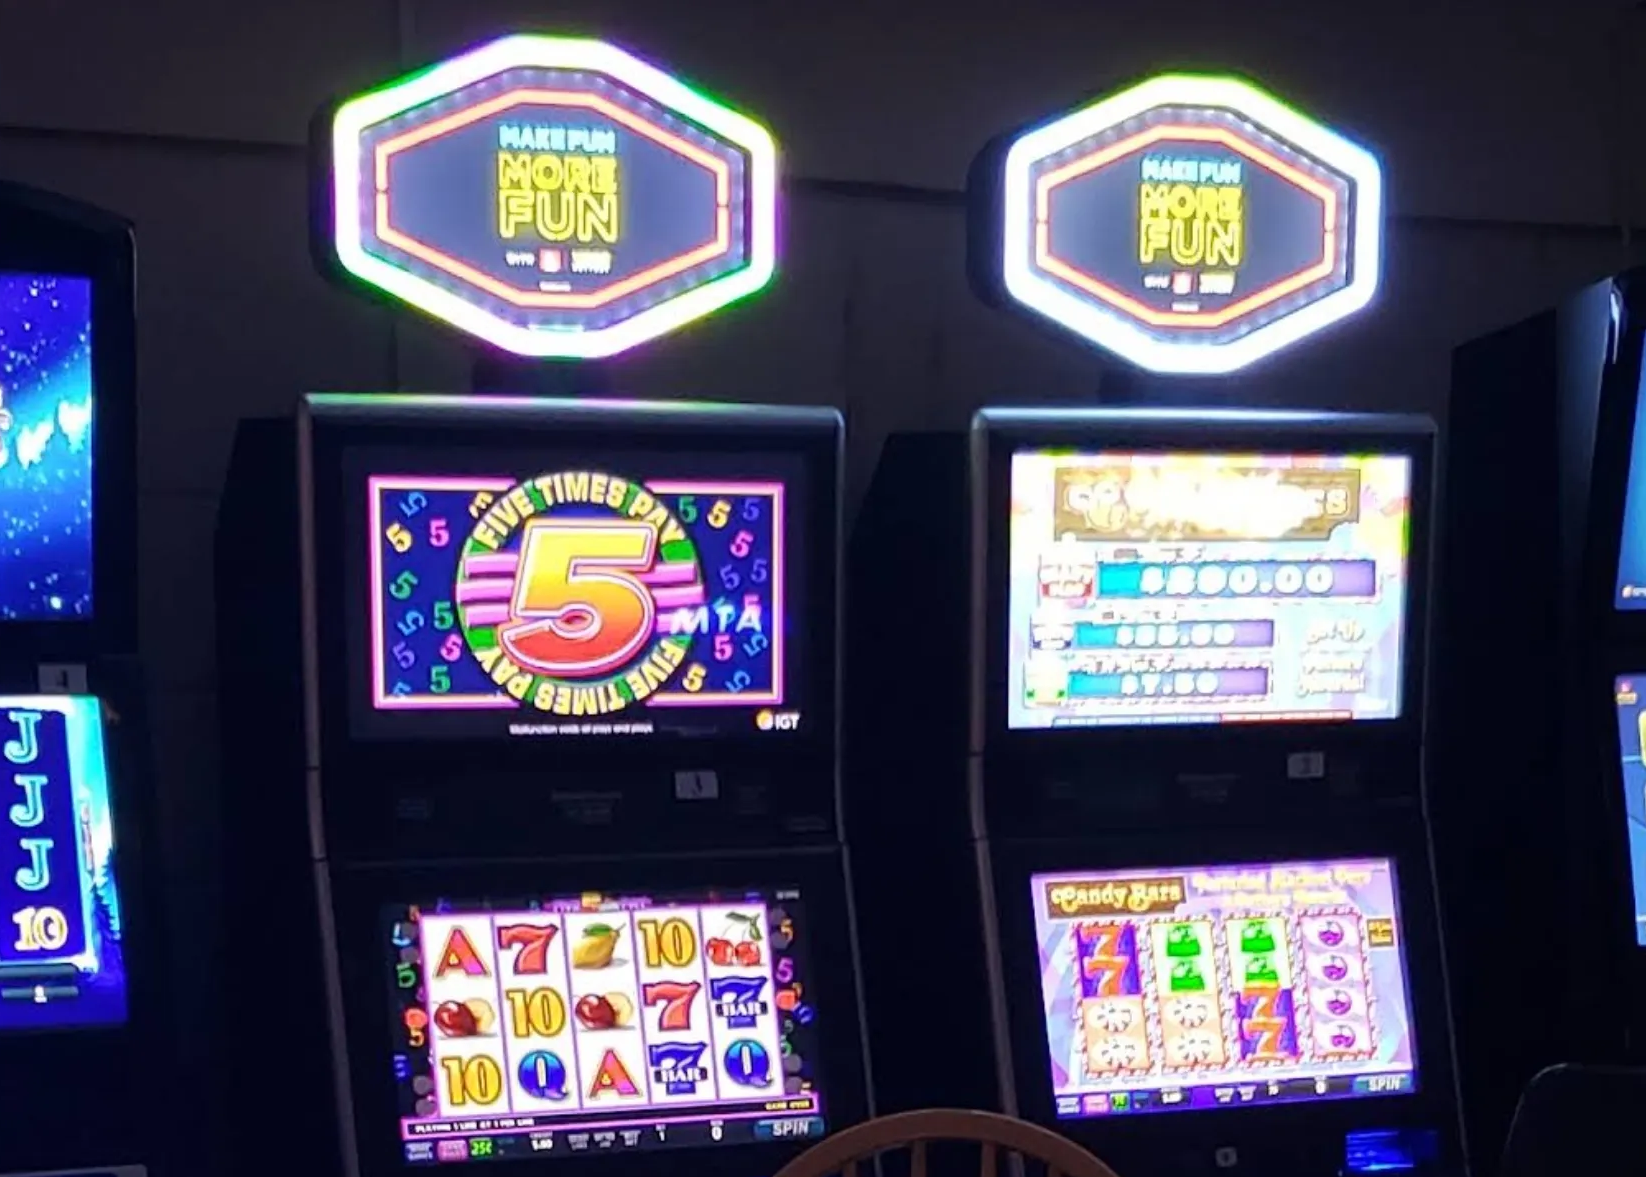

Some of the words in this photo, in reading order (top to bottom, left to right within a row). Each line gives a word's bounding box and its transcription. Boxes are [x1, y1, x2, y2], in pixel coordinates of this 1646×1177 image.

[499, 124, 566, 151] MAKE
[567, 128, 616, 154] FUN
[498, 151, 617, 195] MORE
[1141, 156, 1198, 183] MAKE
[1199, 160, 1242, 184] FUN
[498, 191, 618, 244] FUN
[1140, 184, 1242, 221] MORE
[1140, 218, 1242, 267] FUN
[472, 486, 535, 550] FIVE
[533, 471, 628, 509] TIMES
[628, 489, 687, 545] PAY
[433, 601, 454, 630] 5
[499, 518, 657, 677] 5
[430, 666, 451, 693] 5
[474, 646, 534, 700] PAY
[626, 637, 687, 701] FIVE
[534, 682, 626, 717] TIMES
[4, 710, 43, 765] J
[774, 712, 800, 730] IGT
[9, 773, 48, 828] J
[15, 837, 54, 893] J
[1050, 884, 1127, 915] Candy
[1130, 879, 1182, 912] Bars
[13, 906, 68, 952] 10
[434, 925, 491, 979] A
[497, 922, 560, 976] 7
[638, 917, 697, 969] 10
[1082, 925, 1120, 957] 7
[1085, 956, 1129, 997] 7
[506, 986, 566, 1039] 10
[643, 980, 702, 1032] 7
[720, 1001, 761, 1017] BAR
[1242, 984, 1282, 1021] 7
[1245, 1020, 1287, 1061] 7
[441, 1054, 503, 1107] 10
[517, 1049, 569, 1102] Q
[586, 1047, 643, 1099] A
[723, 1038, 773, 1090] Q
[660, 1066, 703, 1083] BAR
[1368, 1077, 1400, 1092] SPIN
[772, 1120, 809, 1137] SPIN
